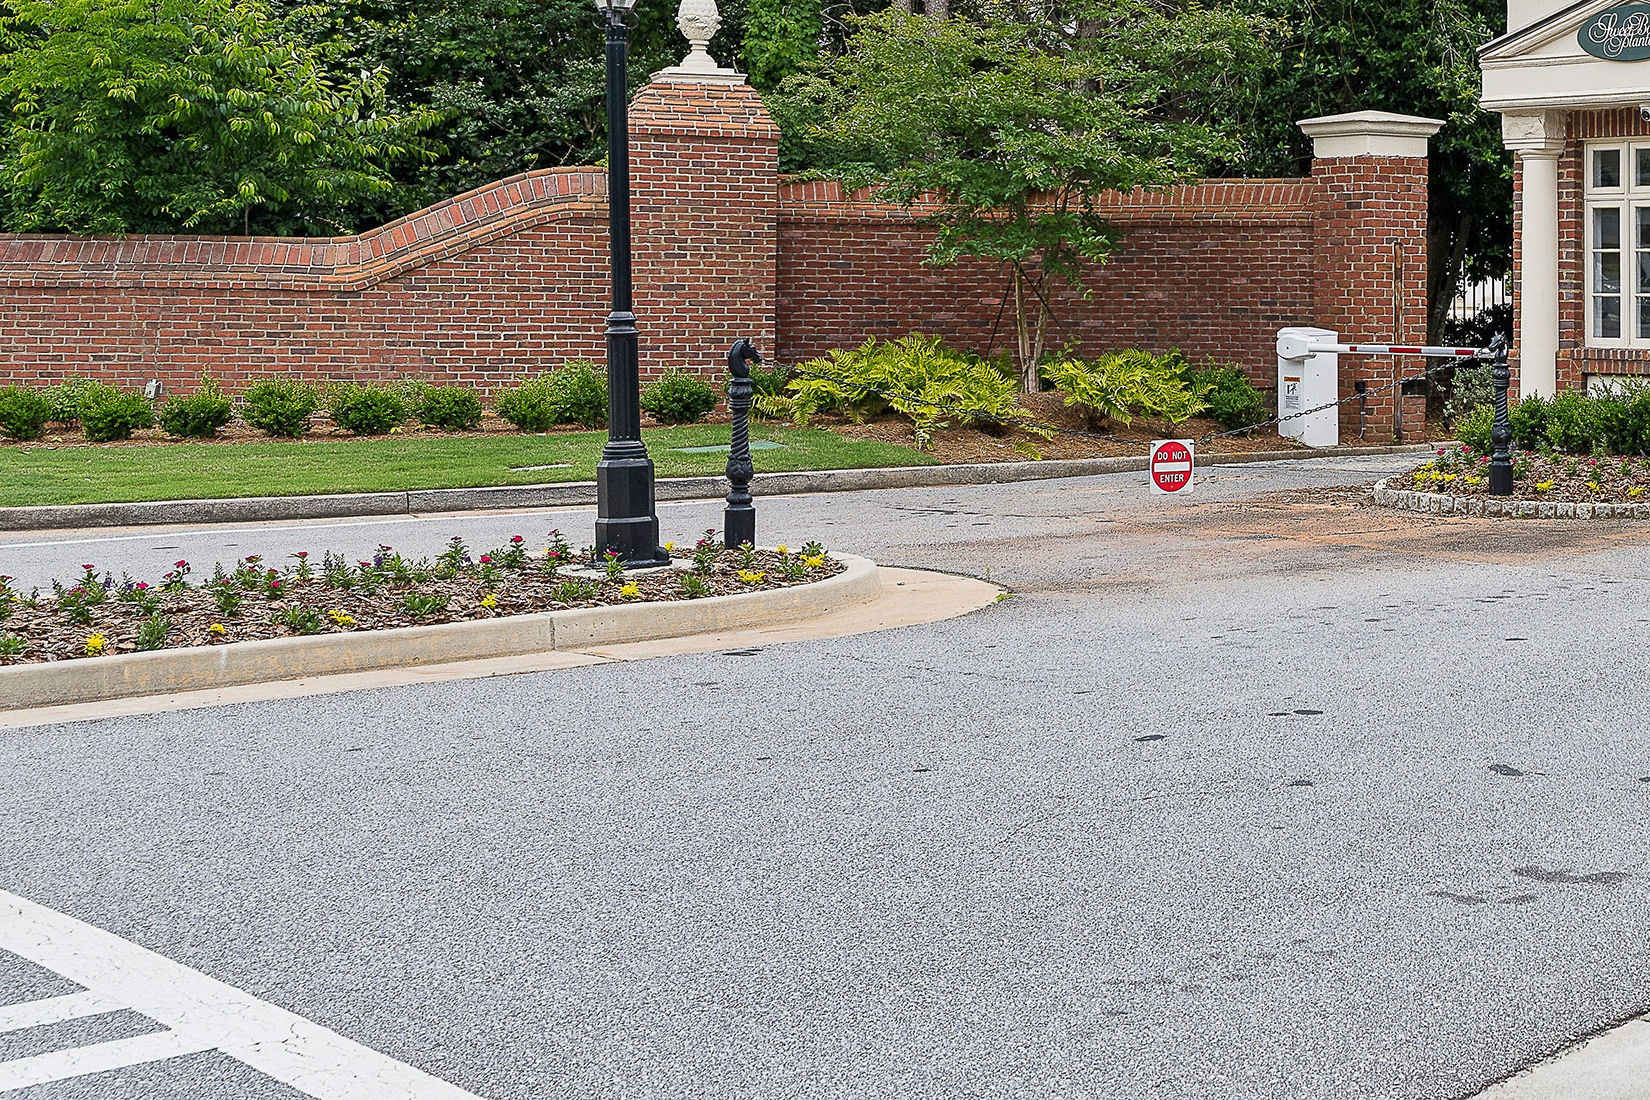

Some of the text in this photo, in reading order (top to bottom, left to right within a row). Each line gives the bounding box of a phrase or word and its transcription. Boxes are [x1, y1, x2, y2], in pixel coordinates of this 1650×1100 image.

[1588, 12, 1632, 43] Sweet
[1158, 451, 1187, 460] DO NOT
[1160, 474, 1184, 483] ENTER
